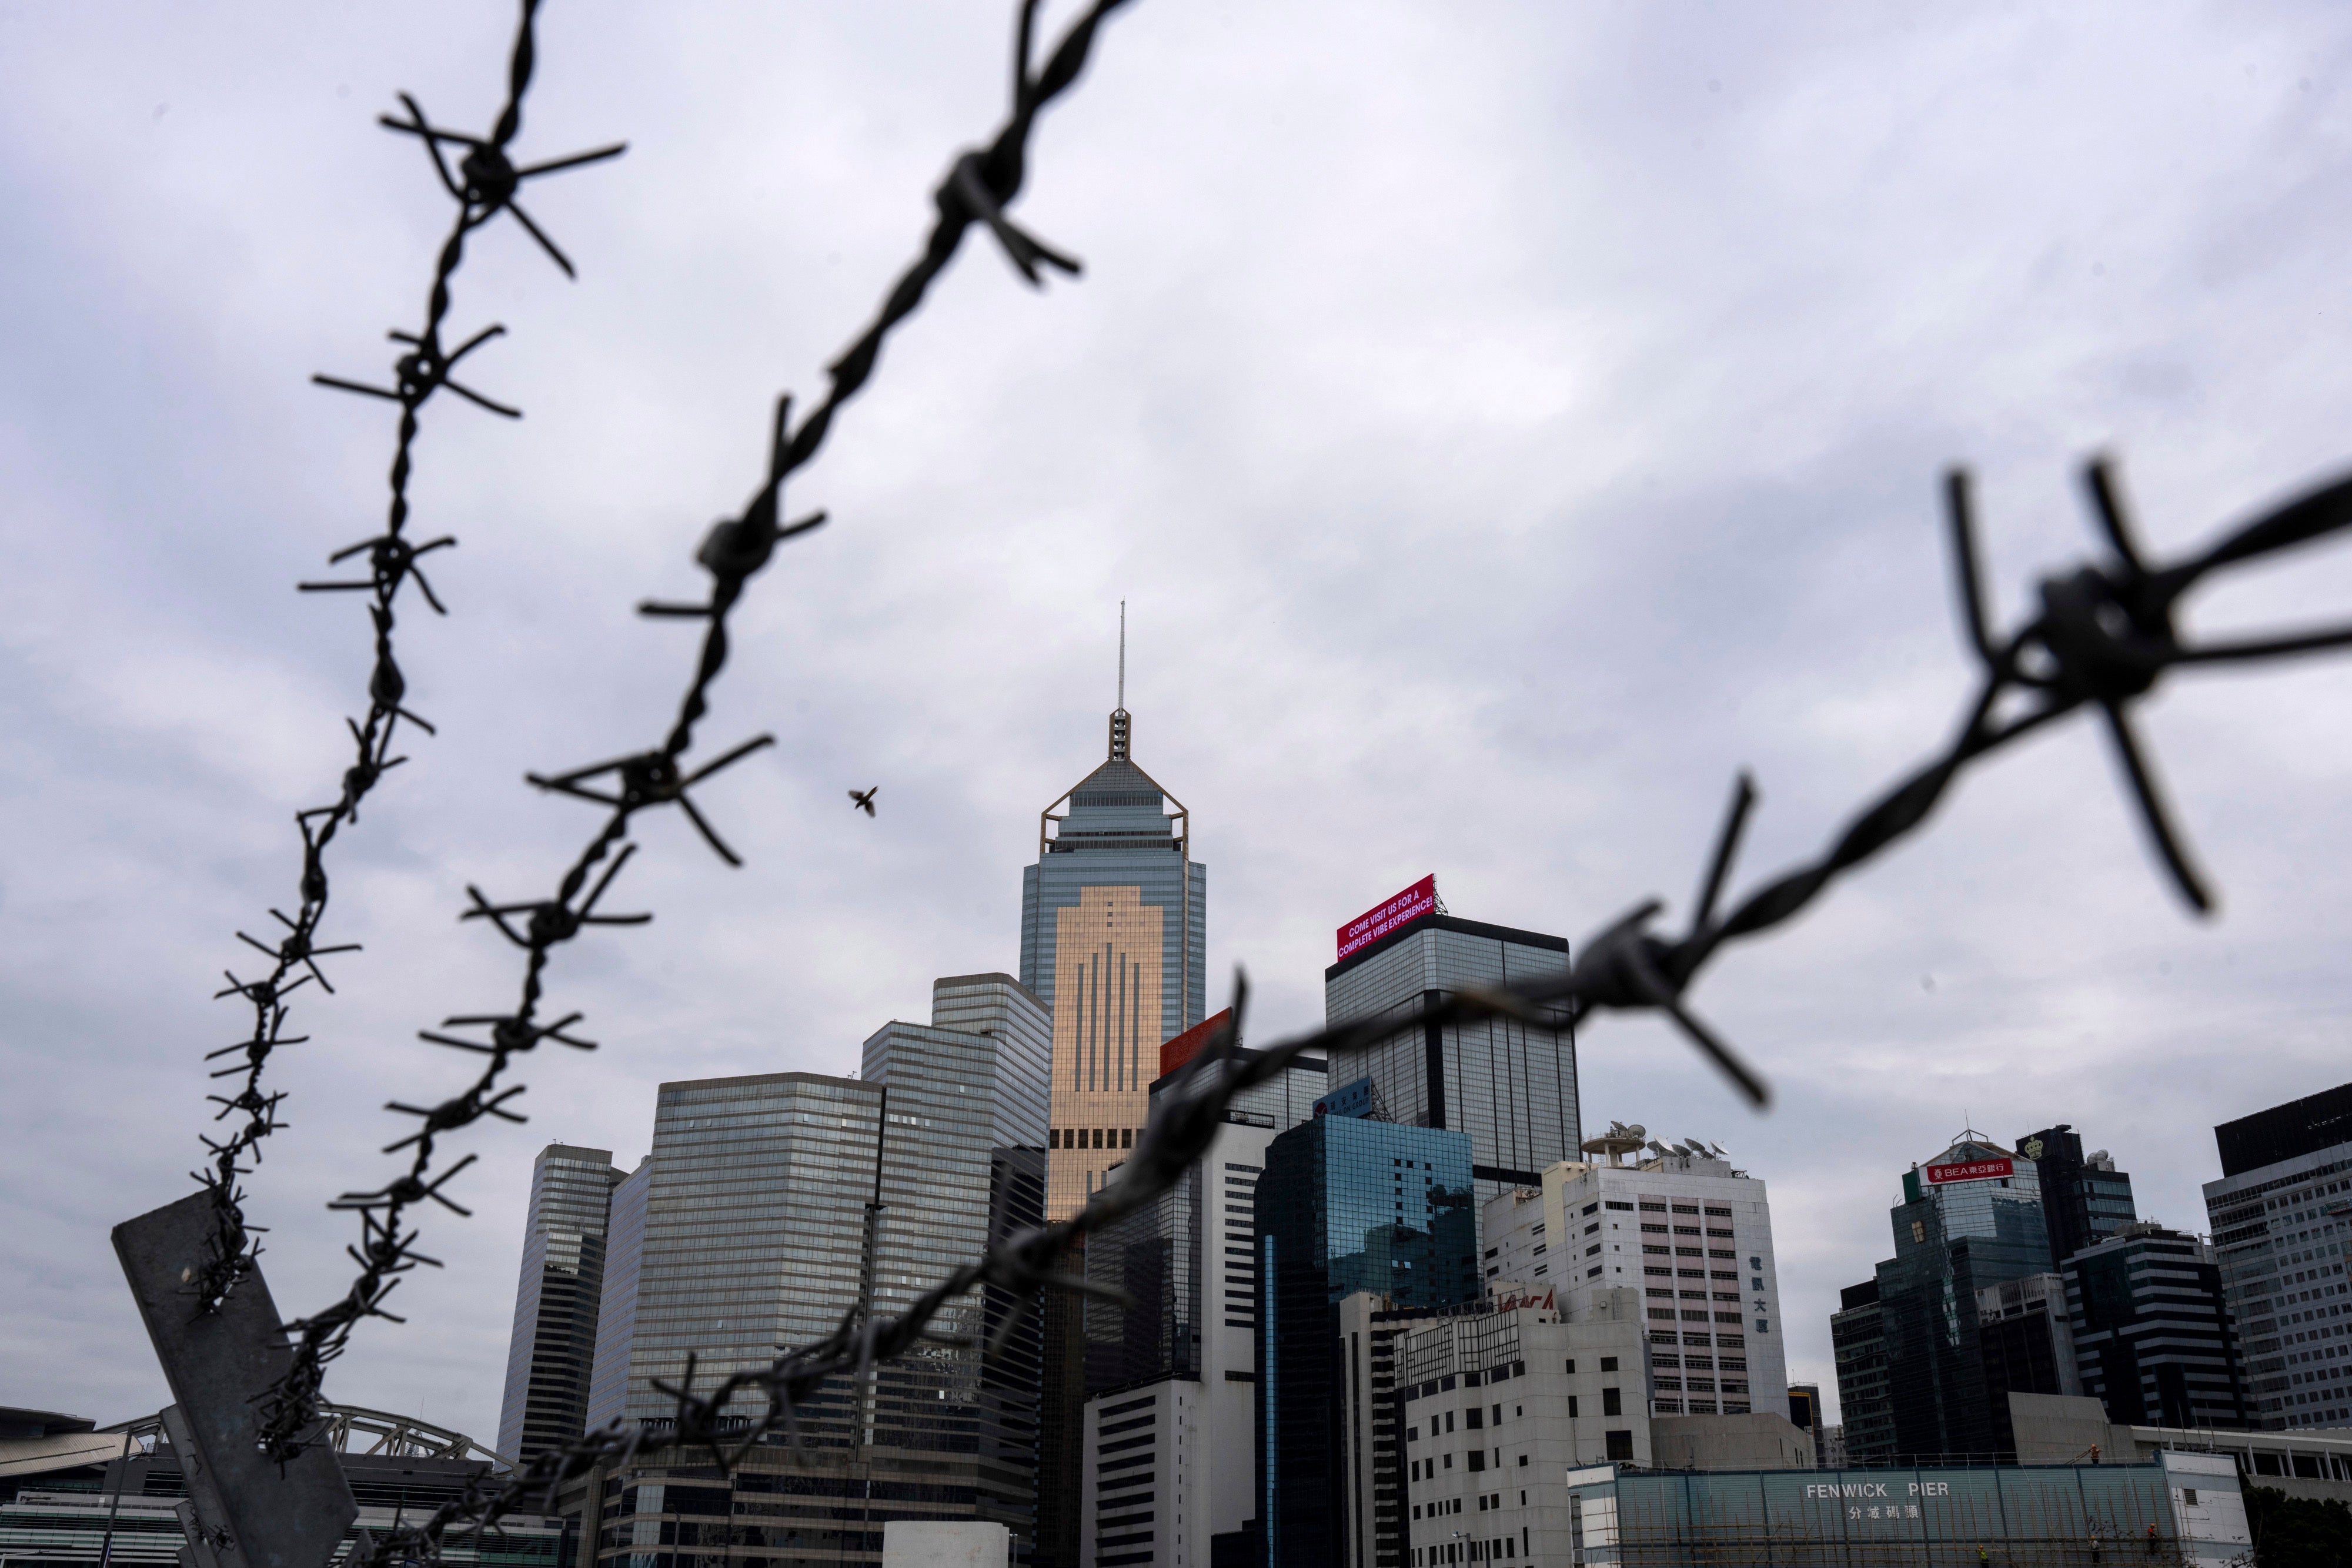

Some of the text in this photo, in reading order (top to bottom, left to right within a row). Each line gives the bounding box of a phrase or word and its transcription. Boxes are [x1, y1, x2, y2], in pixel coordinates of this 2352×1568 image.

[1349, 890, 1419, 938] COME VISIT US FOR A
[1338, 896, 1432, 957] COMPLETE VIBE EXPERIENCE!
[1344, 1105, 1351, 1114] ON
[1352, 1097, 1369, 1110] GROUP
[1945, 1164, 2004, 1177] BEA 東亞銀行
[1749, 1256, 1769, 1333] 電訊大廈
[1806, 1482, 1949, 1498] FENWICK PIER
[1849, 1505, 1919, 1520] 分域碼頭
